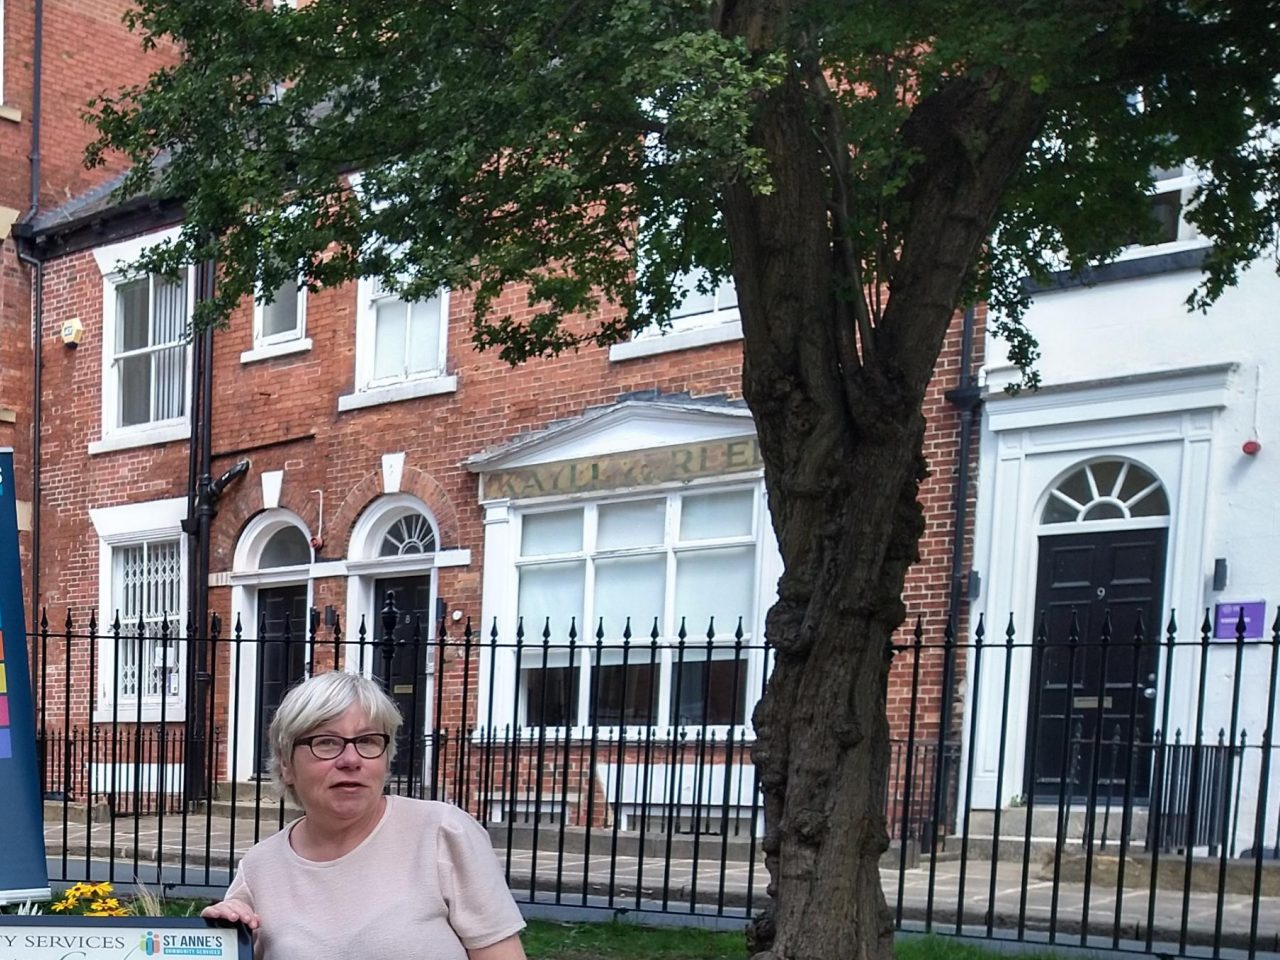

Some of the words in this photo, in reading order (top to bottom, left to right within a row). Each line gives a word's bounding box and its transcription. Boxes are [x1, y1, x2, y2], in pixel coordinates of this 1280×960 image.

[1096, 586, 1106, 600] 9
[24, 935, 125, 949] SERVICES
[163, 934, 178, 946] ST
[180, 936, 223, 948] ANNE'S
